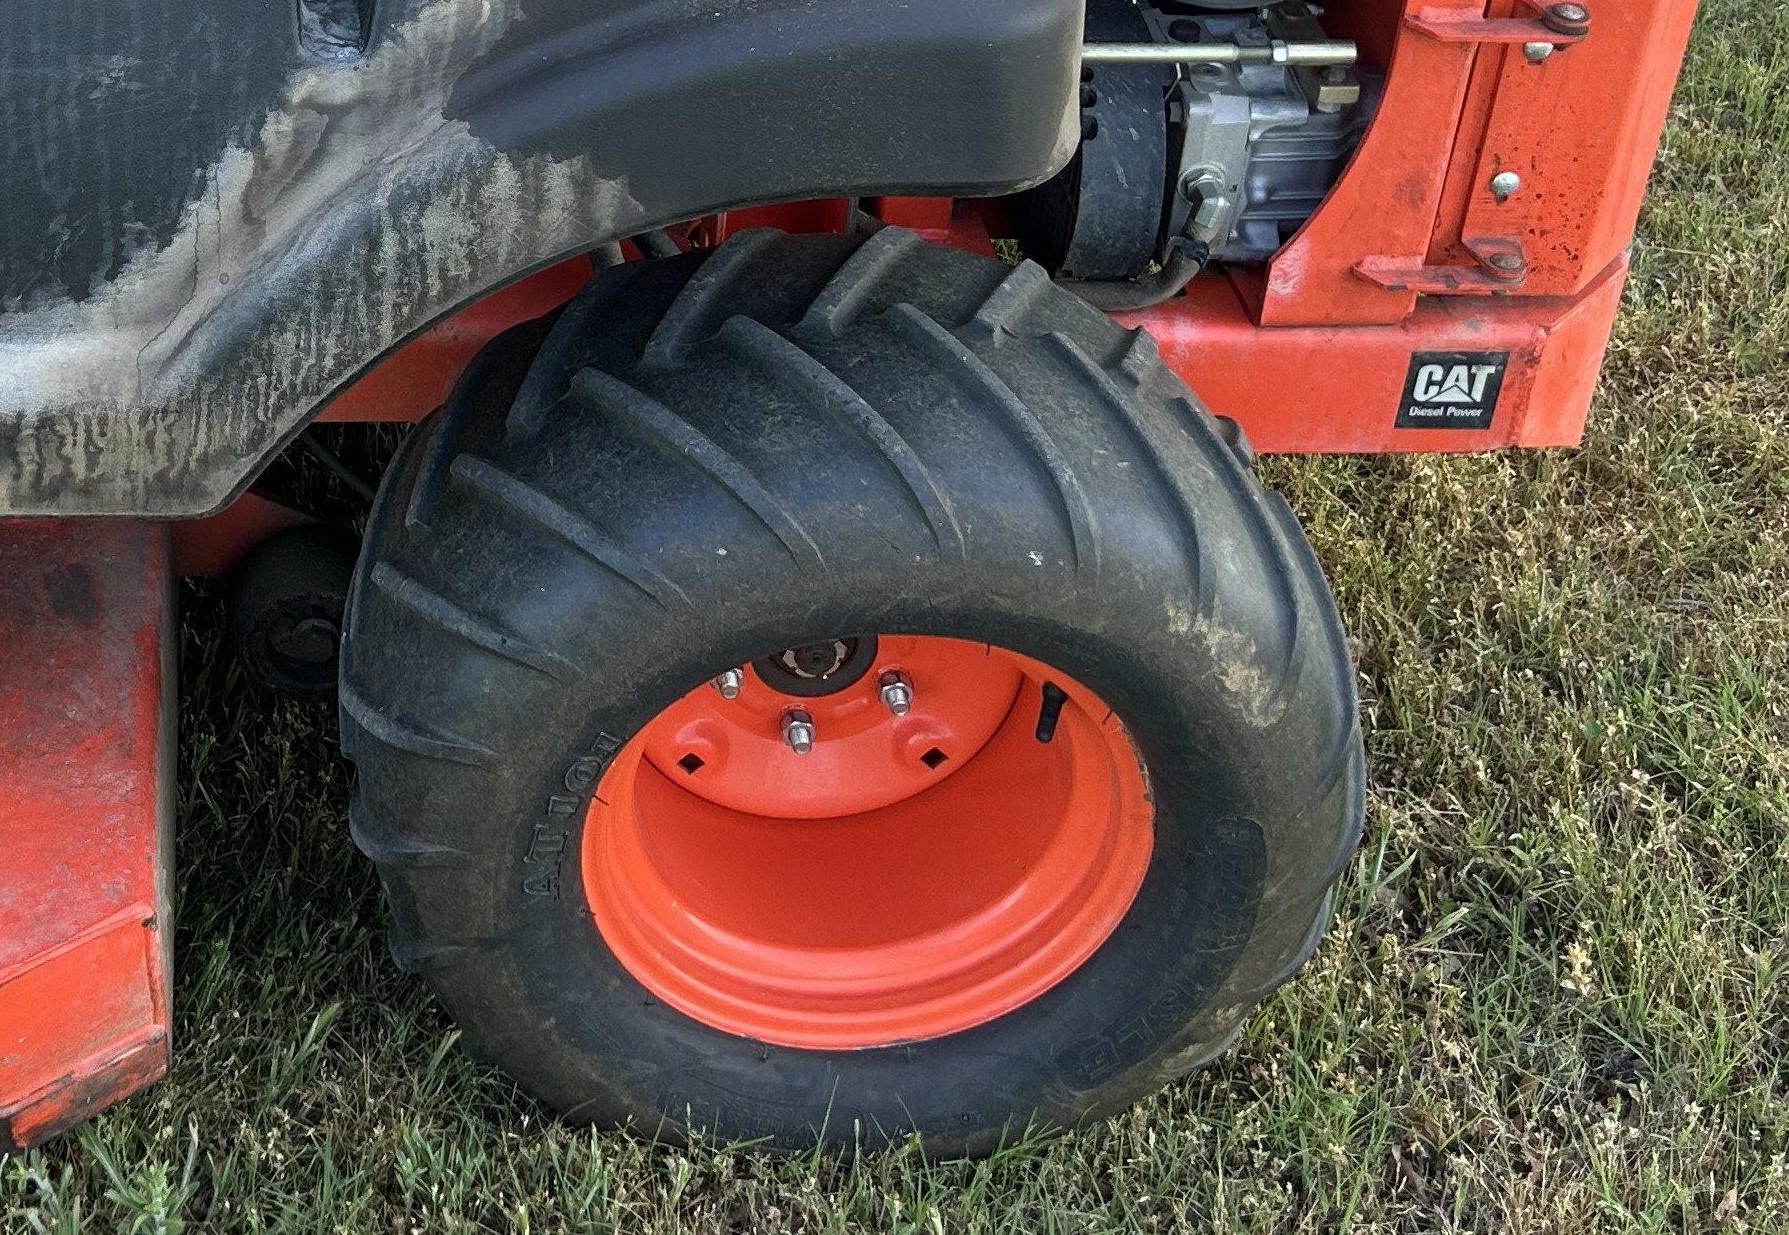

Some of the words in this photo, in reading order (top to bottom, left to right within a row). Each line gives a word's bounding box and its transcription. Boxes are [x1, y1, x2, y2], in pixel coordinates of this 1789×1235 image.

[1412, 363, 1497, 403] CAT
[1408, 405, 1445, 418] Diesel
[1446, 406, 1484, 418] Power
